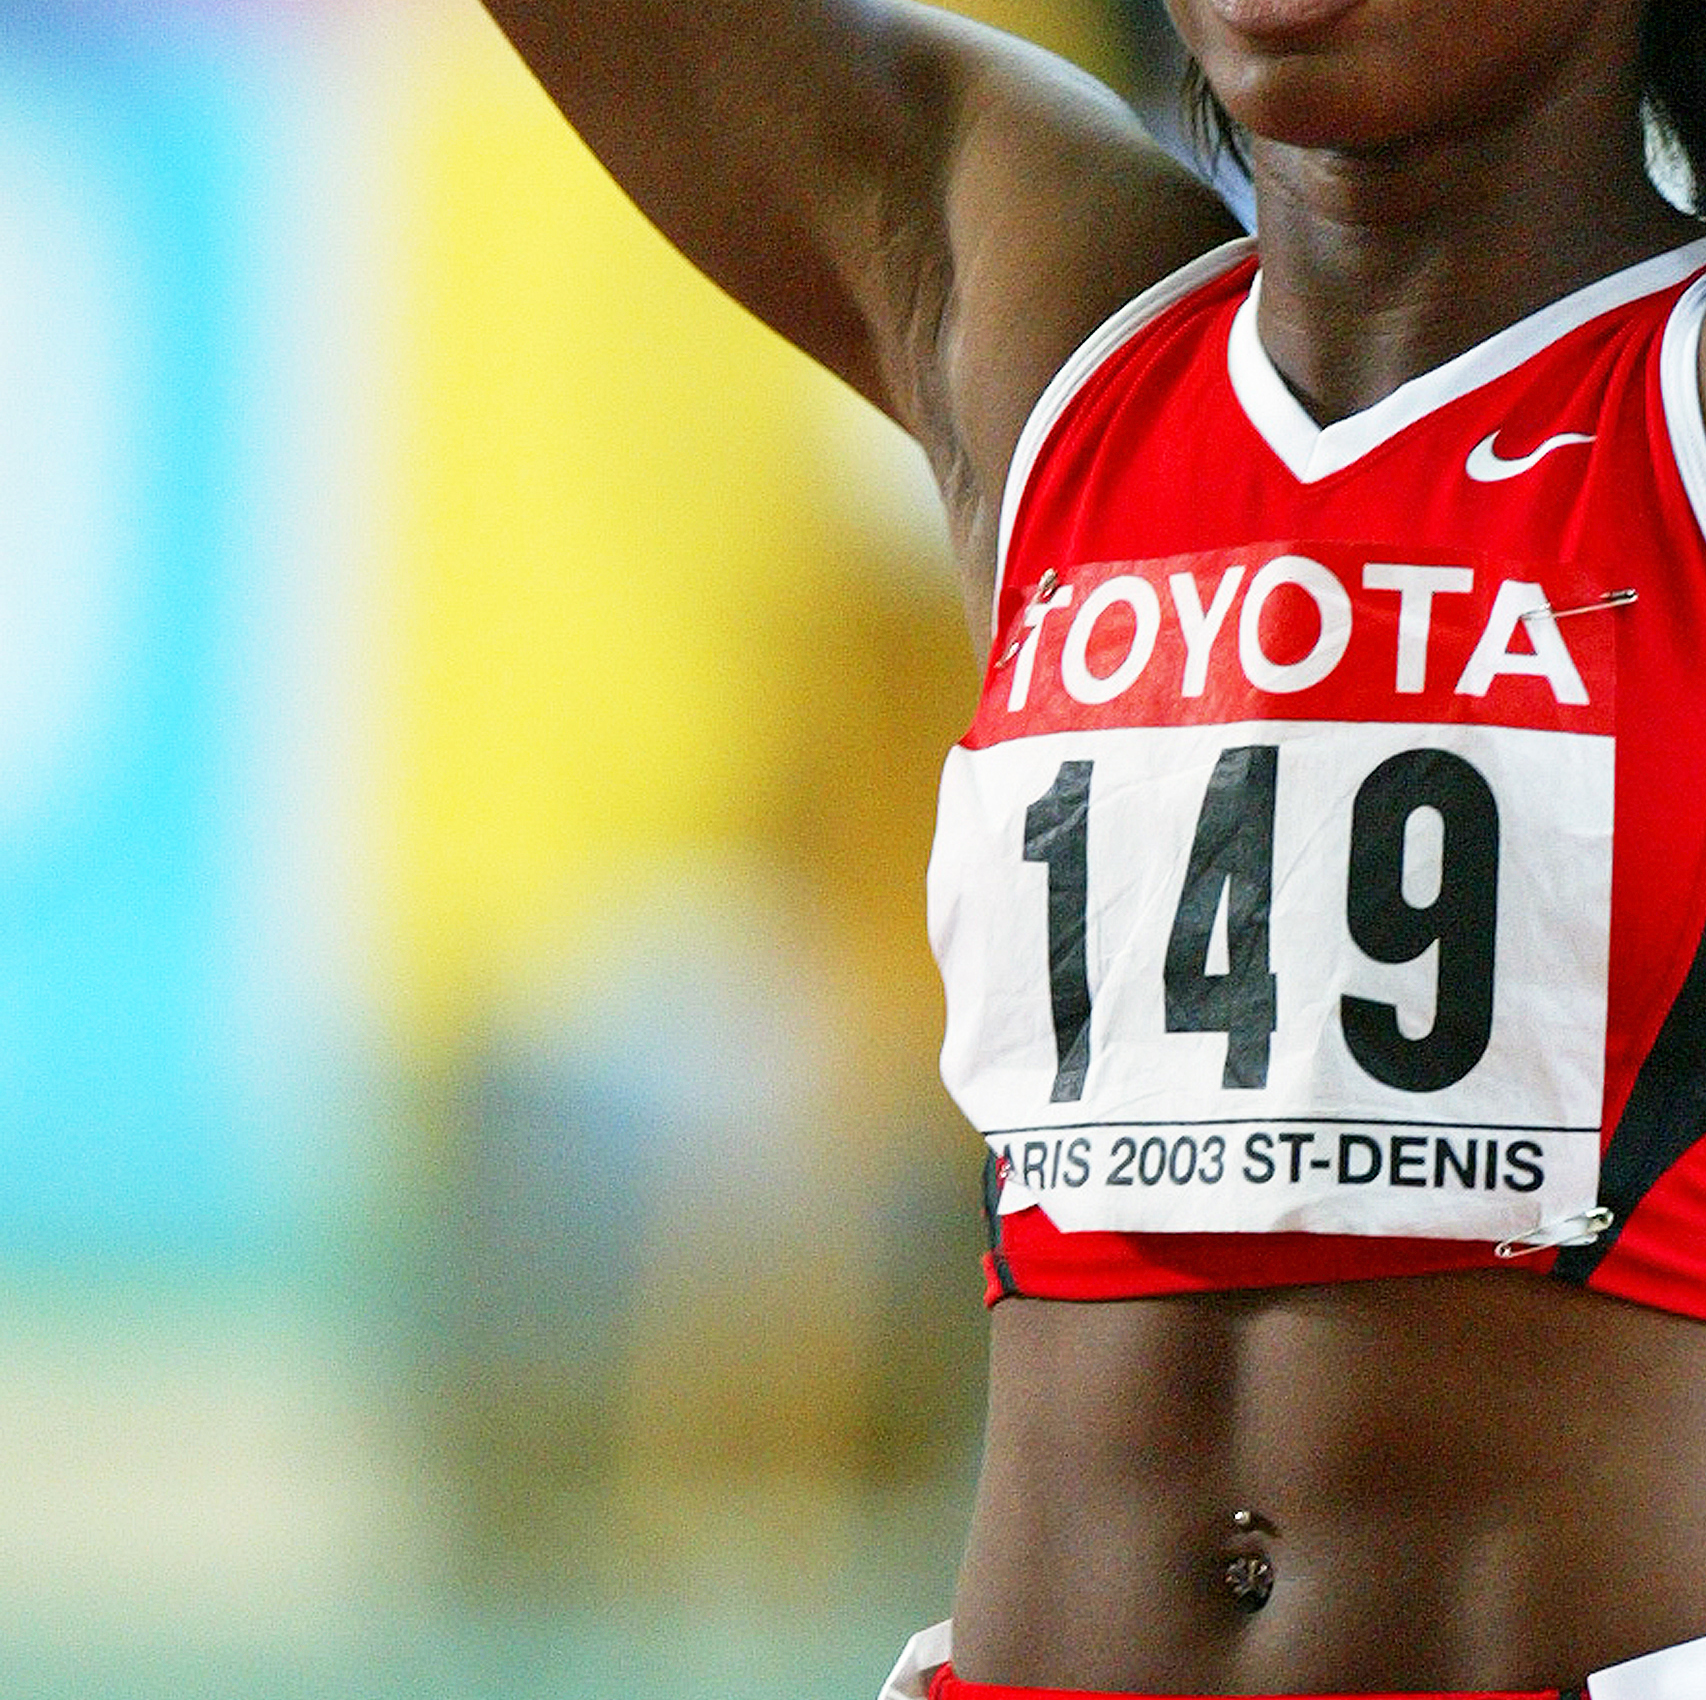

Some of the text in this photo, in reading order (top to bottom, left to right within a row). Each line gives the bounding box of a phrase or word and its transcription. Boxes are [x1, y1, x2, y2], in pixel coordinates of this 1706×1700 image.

[1007, 554, 1592, 712] TOYOTA
[1022, 744, 1502, 1104] 149
[1106, 1135, 1227, 1186] 2003
[1242, 1132, 1546, 1193] ST-DENIS
